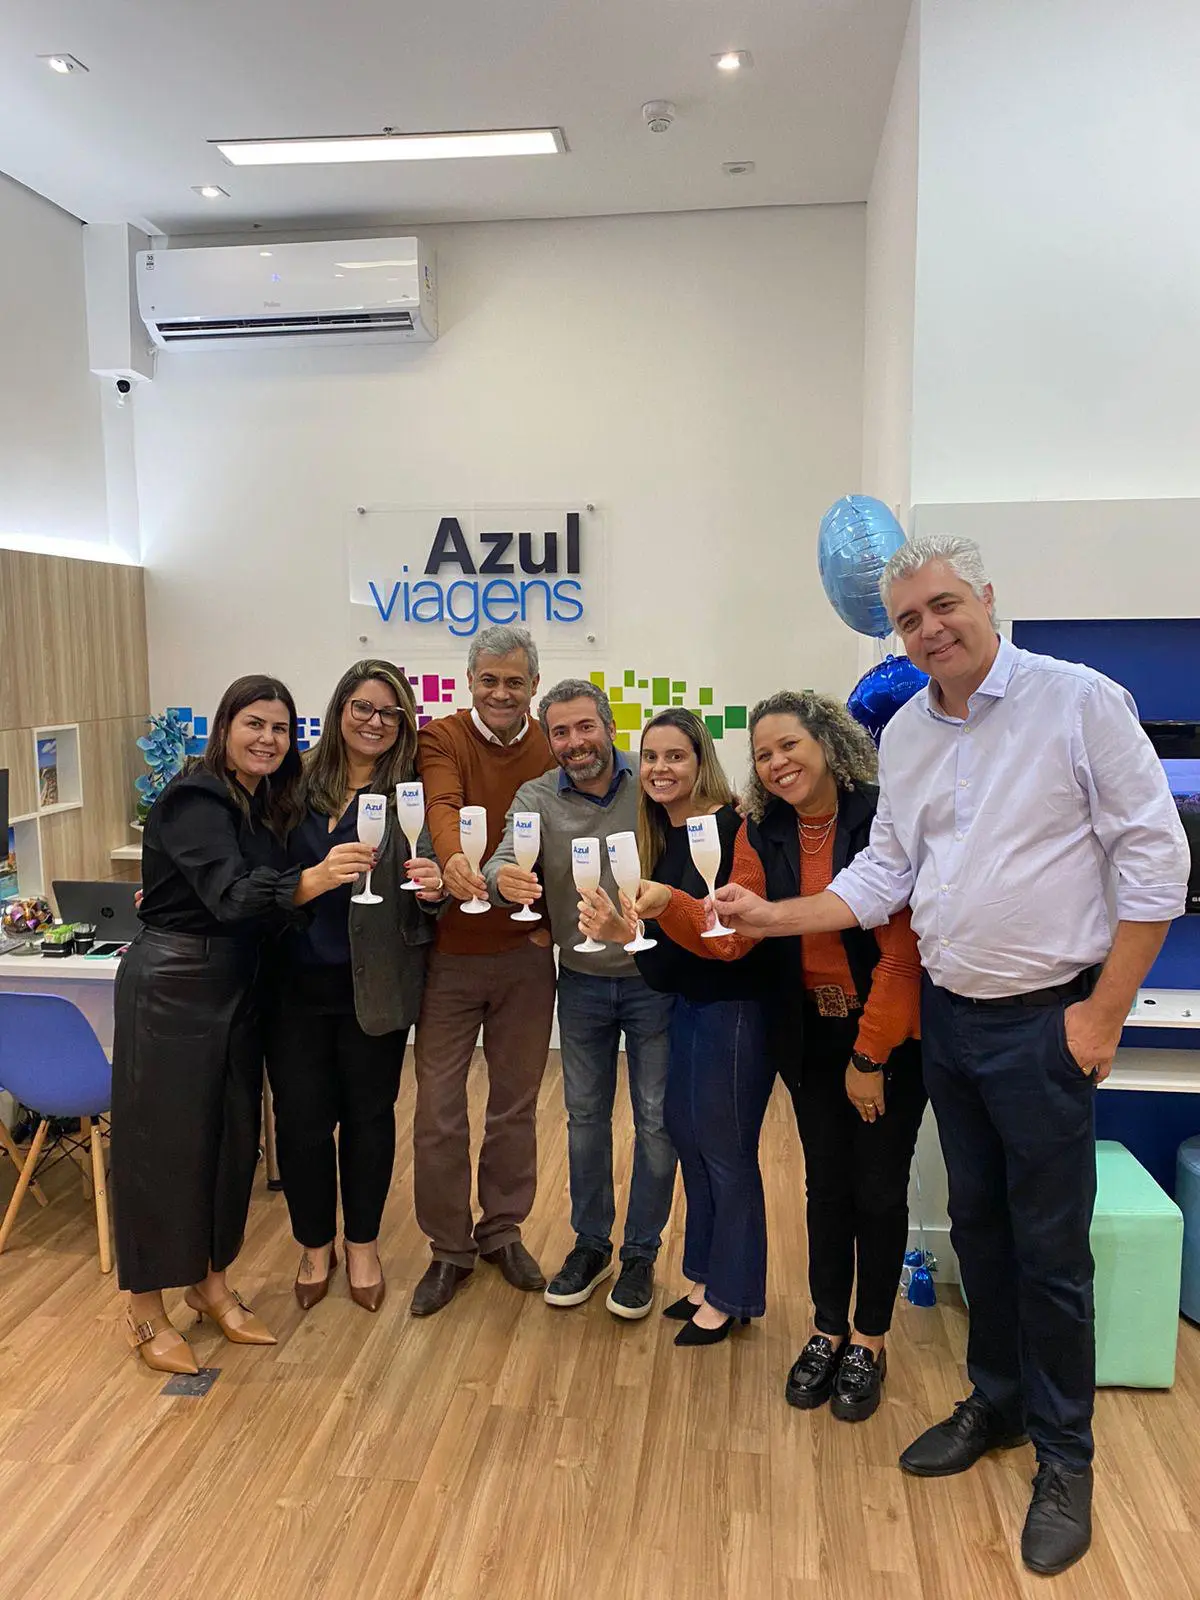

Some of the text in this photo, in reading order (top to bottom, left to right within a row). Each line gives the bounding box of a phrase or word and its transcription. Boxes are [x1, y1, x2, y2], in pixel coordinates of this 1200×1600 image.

[424, 512, 580, 574] Azul
[368, 565, 584, 637] viagens
[402, 789, 419, 798] Azul
[365, 803, 383, 811] Azul
[515, 820, 532, 829] Azul
[573, 846, 589, 854] Azul
